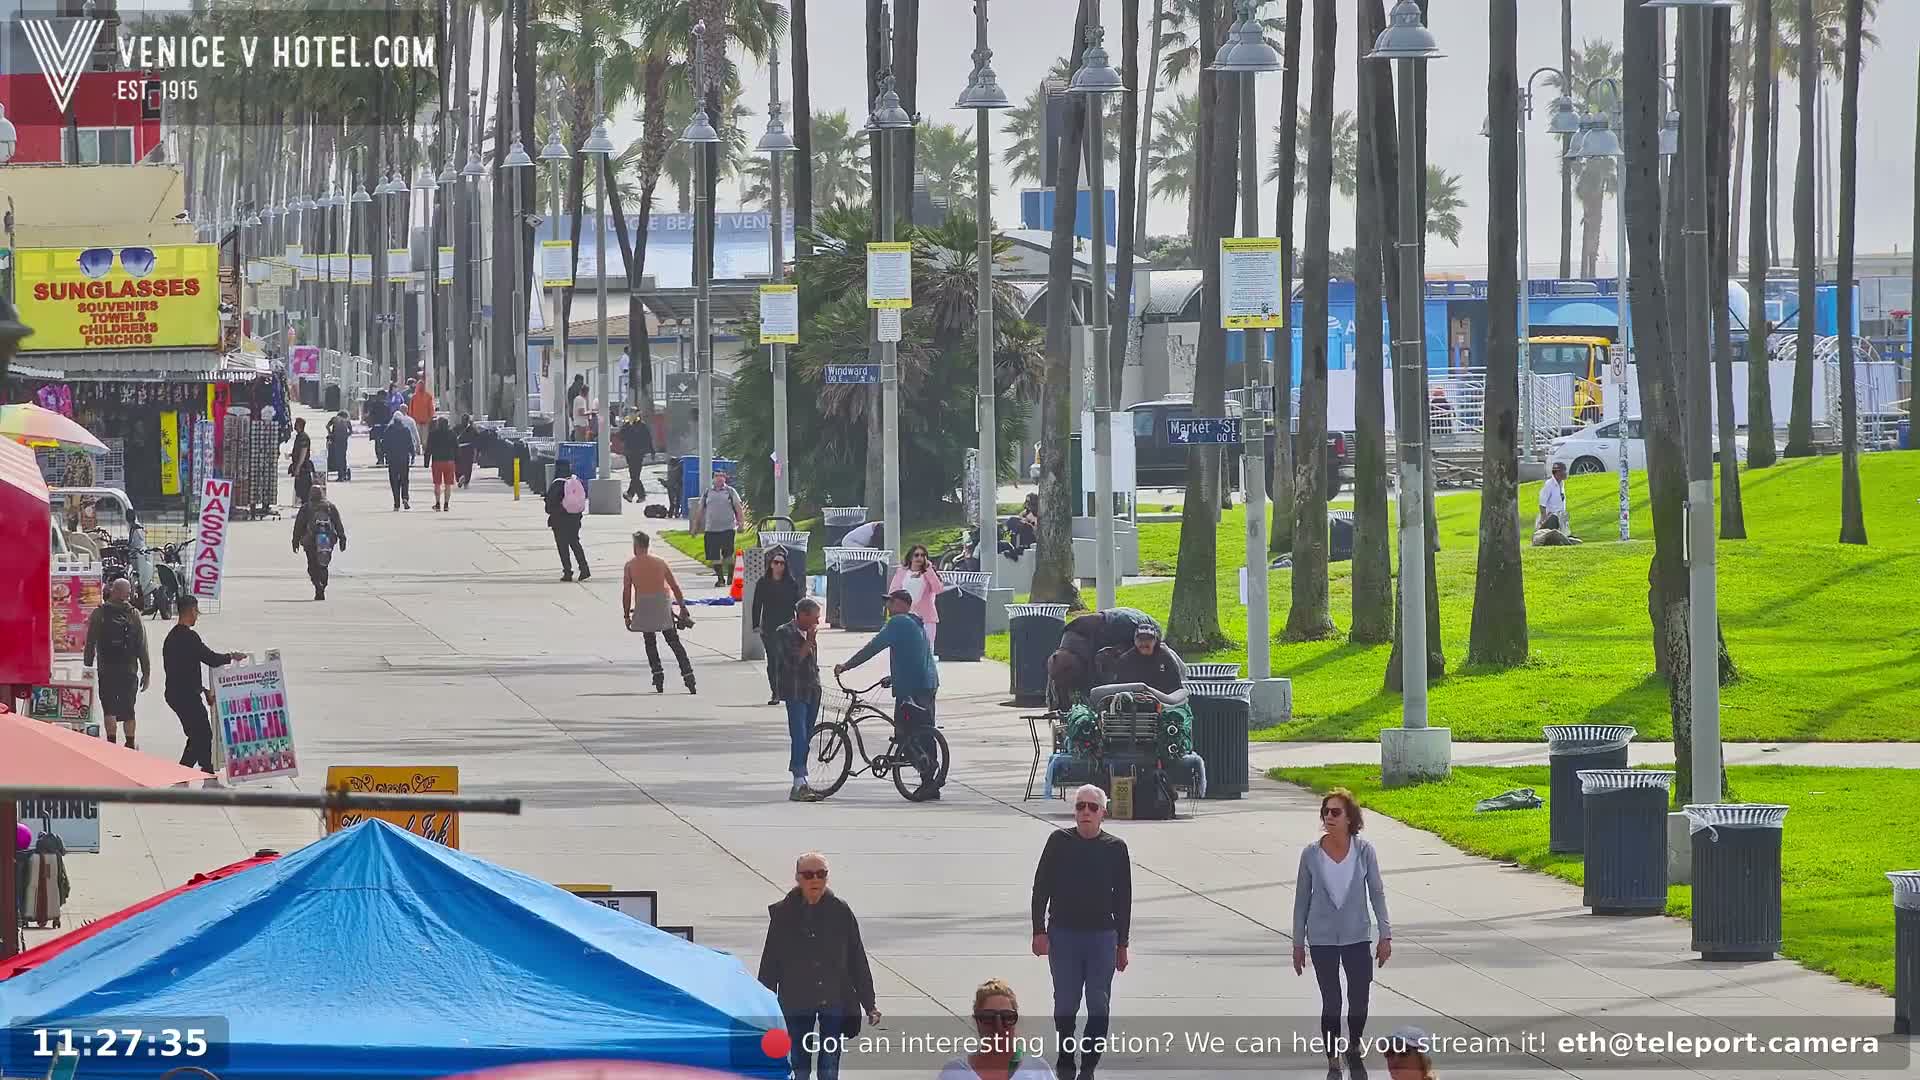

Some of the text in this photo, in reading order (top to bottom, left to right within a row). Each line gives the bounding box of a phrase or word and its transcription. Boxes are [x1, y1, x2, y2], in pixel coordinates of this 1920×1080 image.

[33, 278, 201, 300] SUNGLASSES
[77, 300, 159, 313] SOUVENIRS
[90, 312, 146, 323] TOWELS
[79, 322, 158, 335] CHILDRENS
[85, 333, 153, 345] PONCHOS
[828, 366, 868, 376] Windward
[1170, 420, 1236, 434] Market St
[193, 480, 230, 596] MASSAGE
